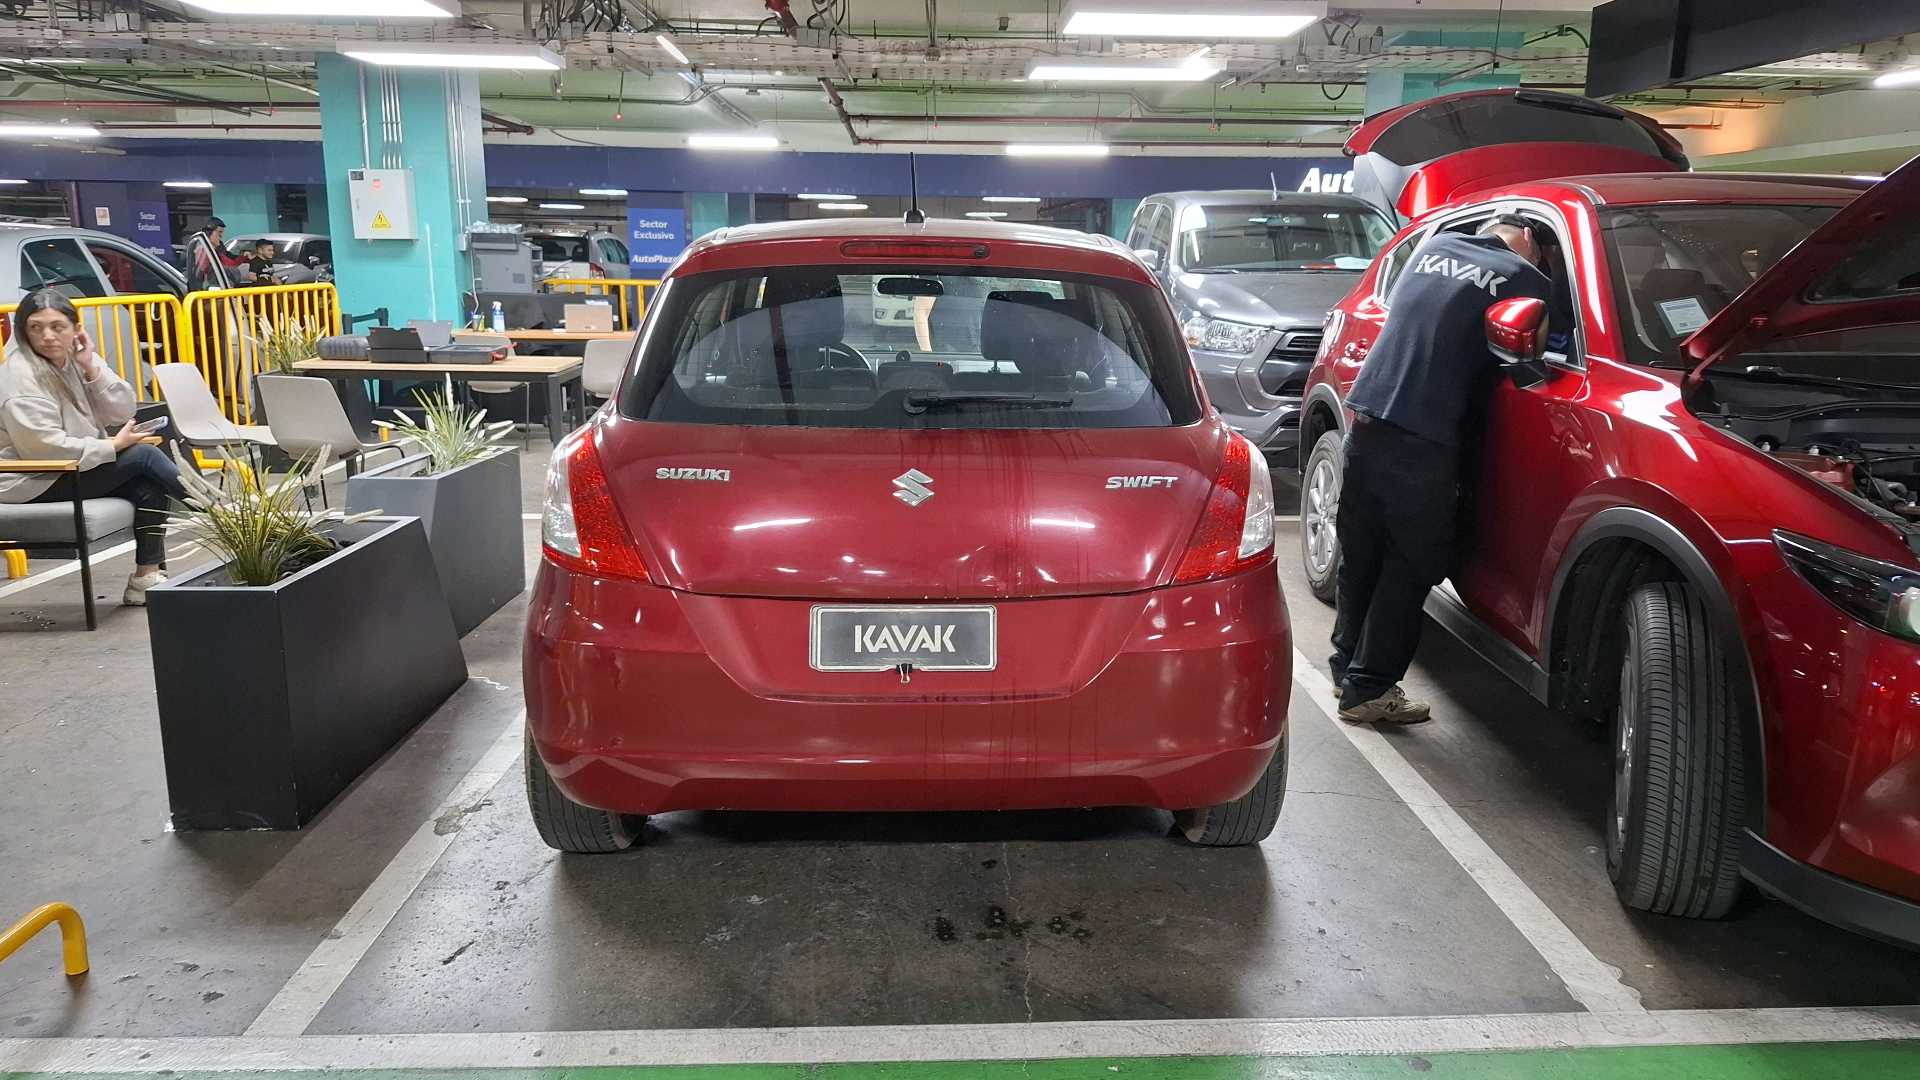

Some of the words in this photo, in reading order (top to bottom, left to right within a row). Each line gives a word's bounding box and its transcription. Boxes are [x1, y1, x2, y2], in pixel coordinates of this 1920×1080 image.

[639, 219, 668, 228] Sector
[633, 231, 675, 240] Exclusivo
[1414, 254, 1508, 297] KAVAK
[656, 467, 730, 481] SUZUKI
[1105, 475, 1178, 488] SWIFT
[854, 625, 956, 652] KAVAK
